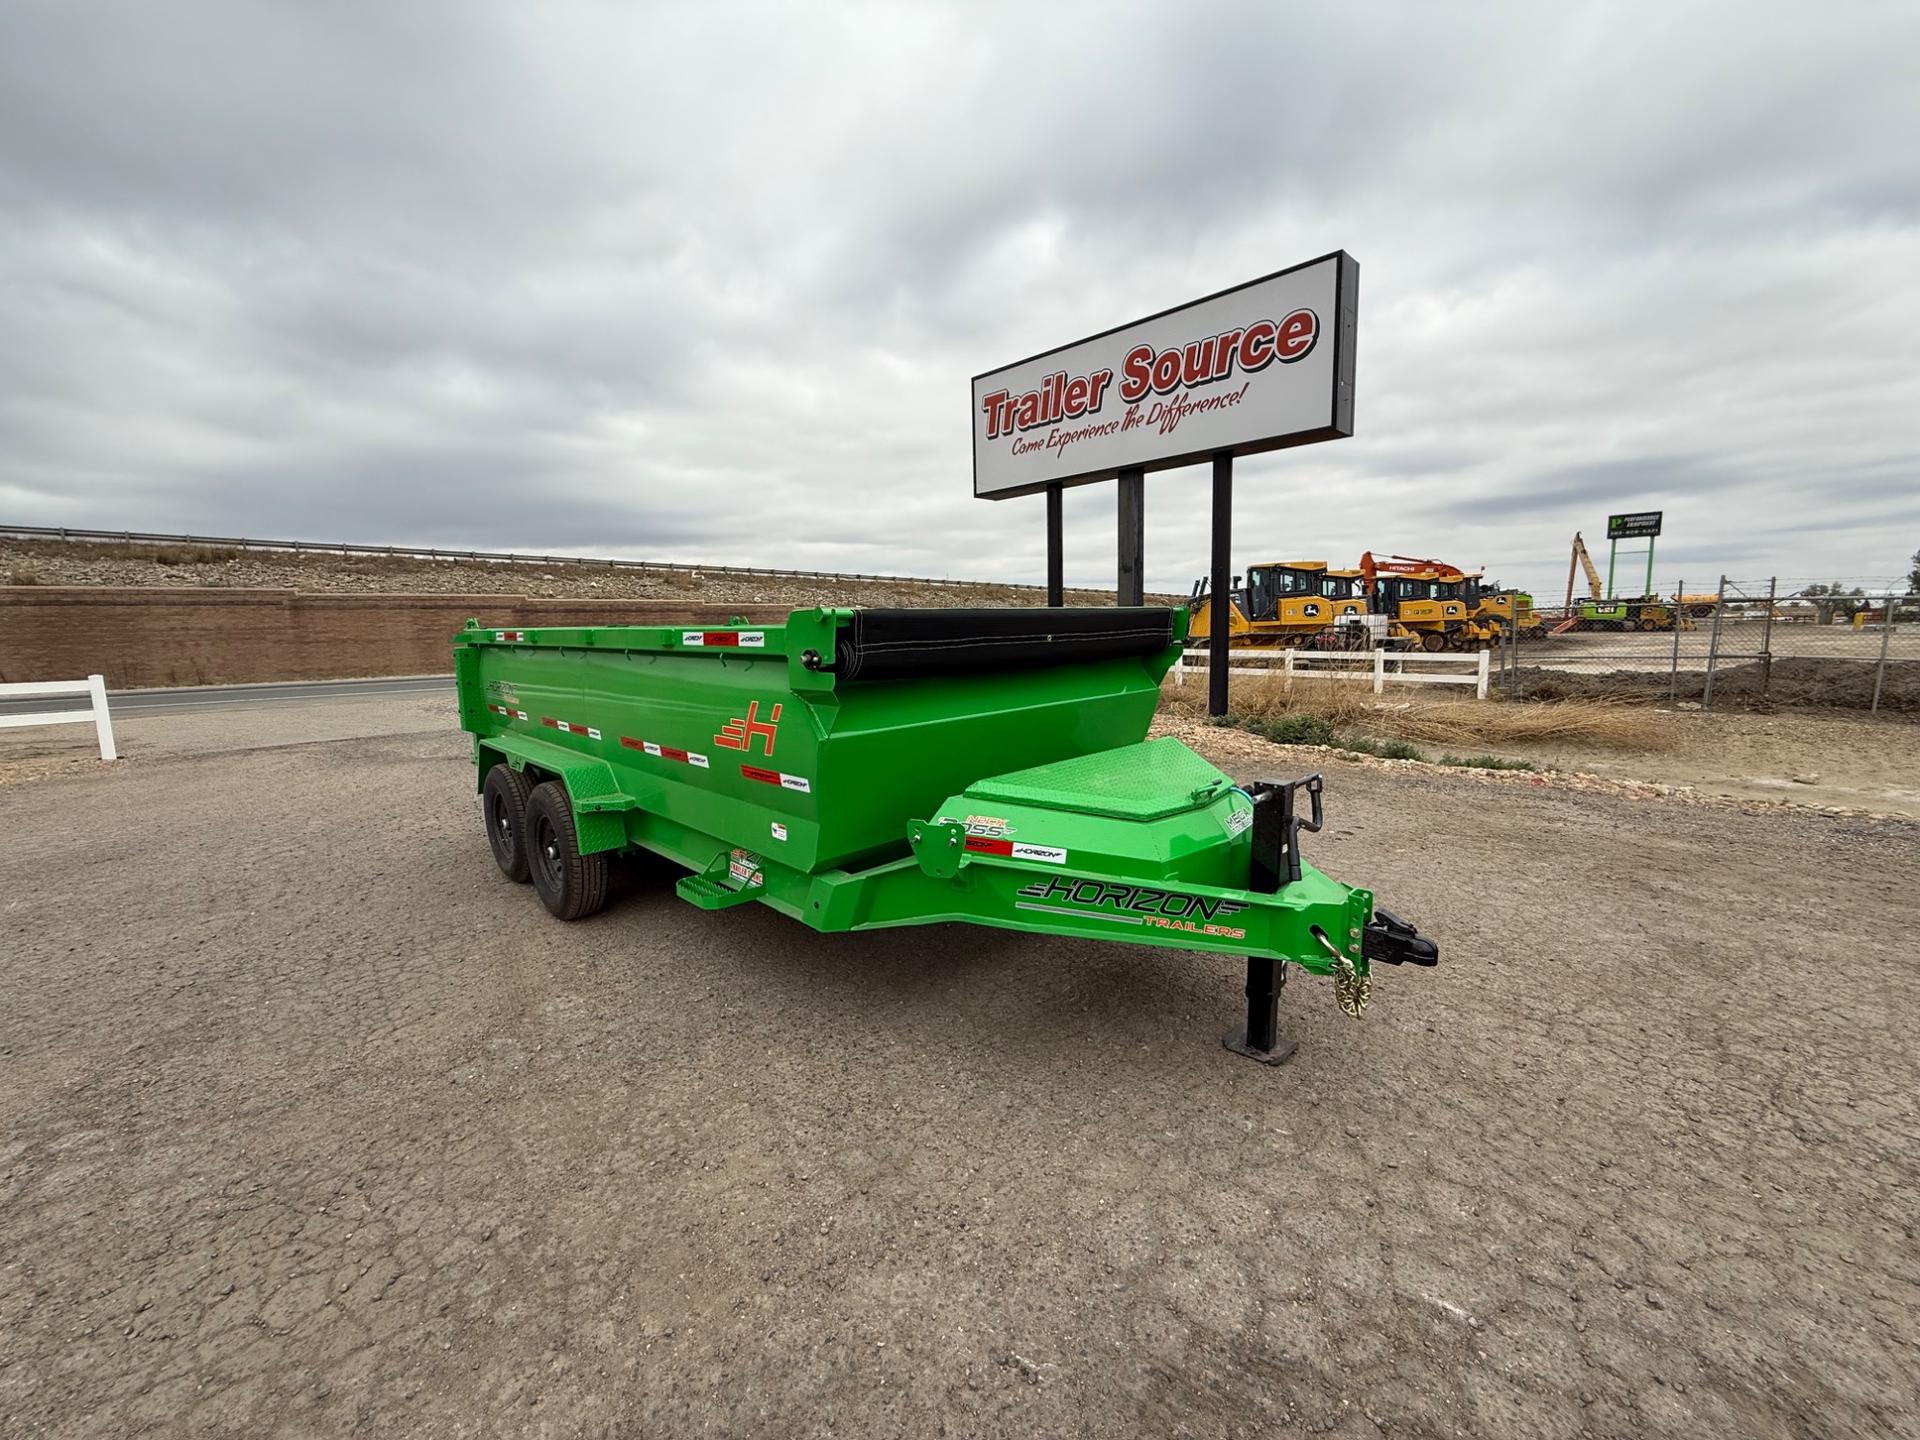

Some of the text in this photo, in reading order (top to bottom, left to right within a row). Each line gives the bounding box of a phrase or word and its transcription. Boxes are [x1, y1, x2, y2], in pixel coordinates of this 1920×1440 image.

[983, 307, 1320, 439] Trailer Source
[1012, 382, 1250, 459] Come Experience the Difference!
[1014, 847, 1062, 858] HORIZON
[1040, 876, 1230, 921] HORIZON
[1143, 916, 1246, 939] TRAILERS
